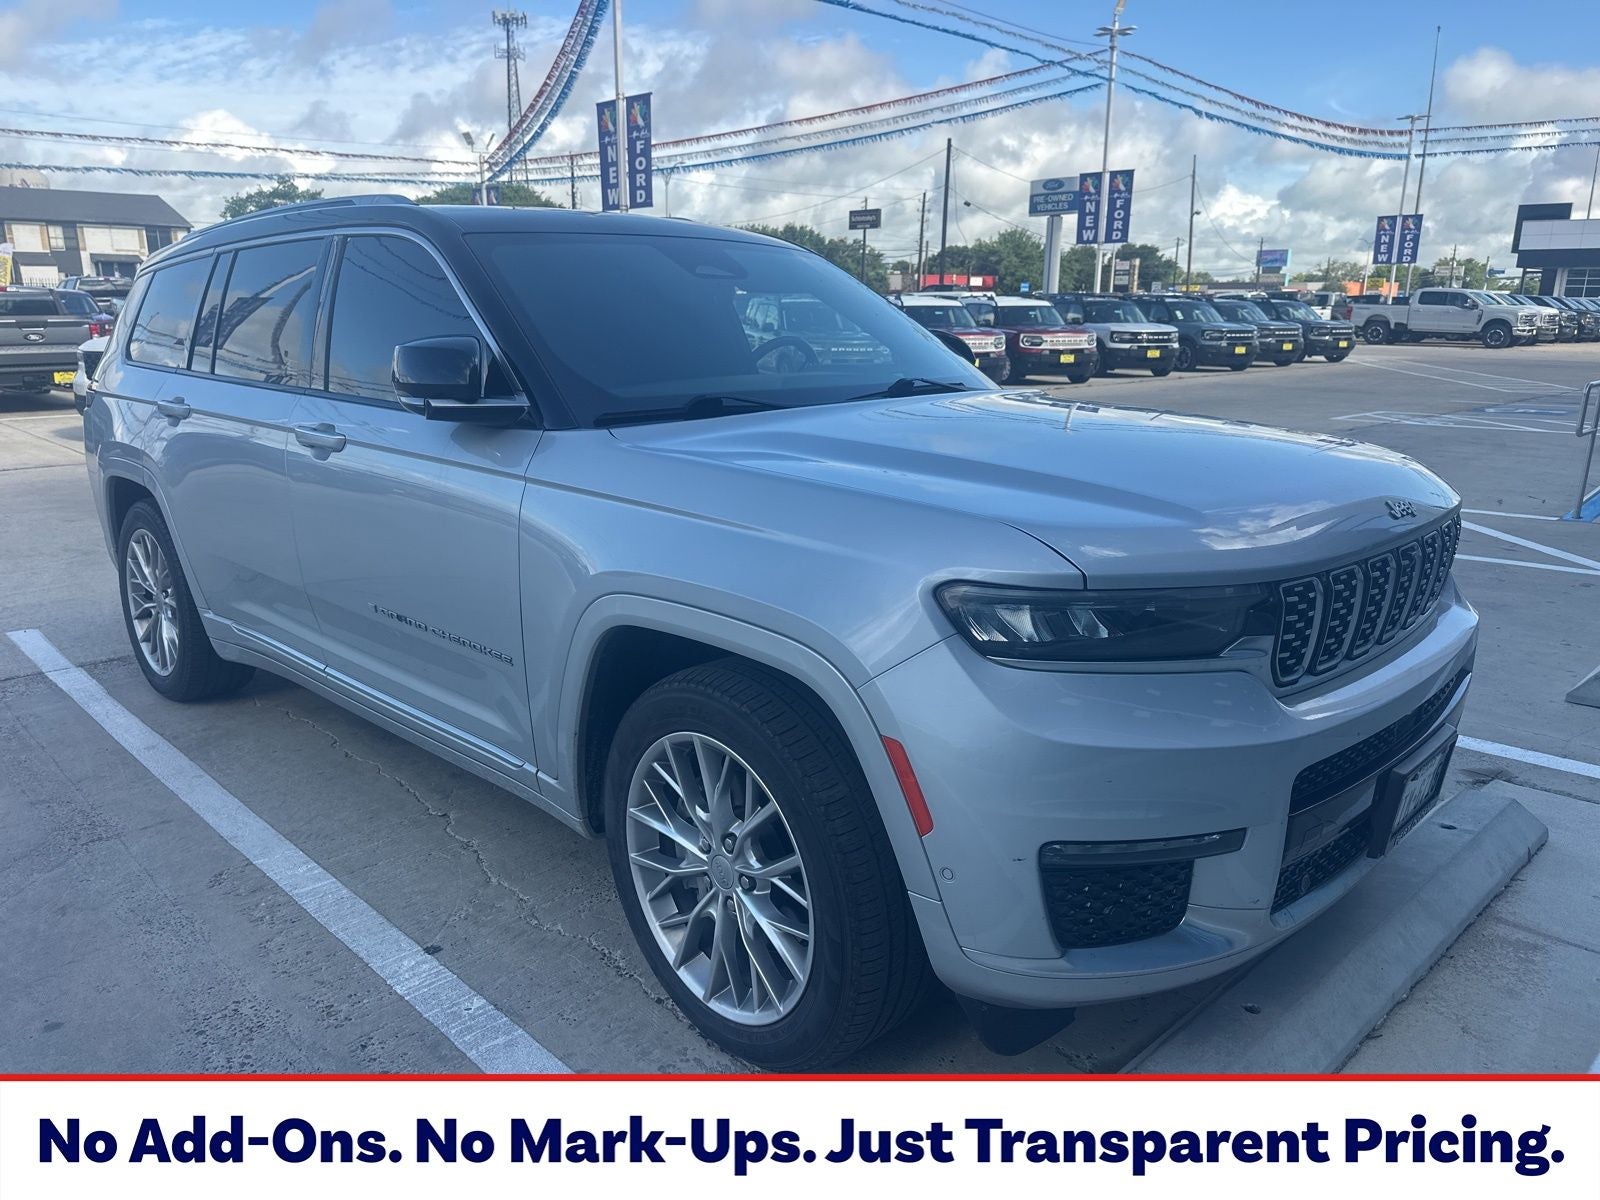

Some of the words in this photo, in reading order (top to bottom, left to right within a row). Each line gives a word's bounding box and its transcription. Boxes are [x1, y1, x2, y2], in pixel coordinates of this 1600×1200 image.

[607, 145, 620, 205] NEW
[635, 141, 646, 203] FORD
[1033, 193, 1074, 203] PRE-OWNED
[1037, 202, 1069, 212] VEHICLES
[1082, 201, 1096, 241] NEW
[1112, 199, 1125, 240] FORD
[1378, 235, 1389, 262] NEW
[1402, 235, 1414, 262] FORD
[1385, 500, 1416, 520] Jeep
[430, 626, 514, 666] CHEROKEE
